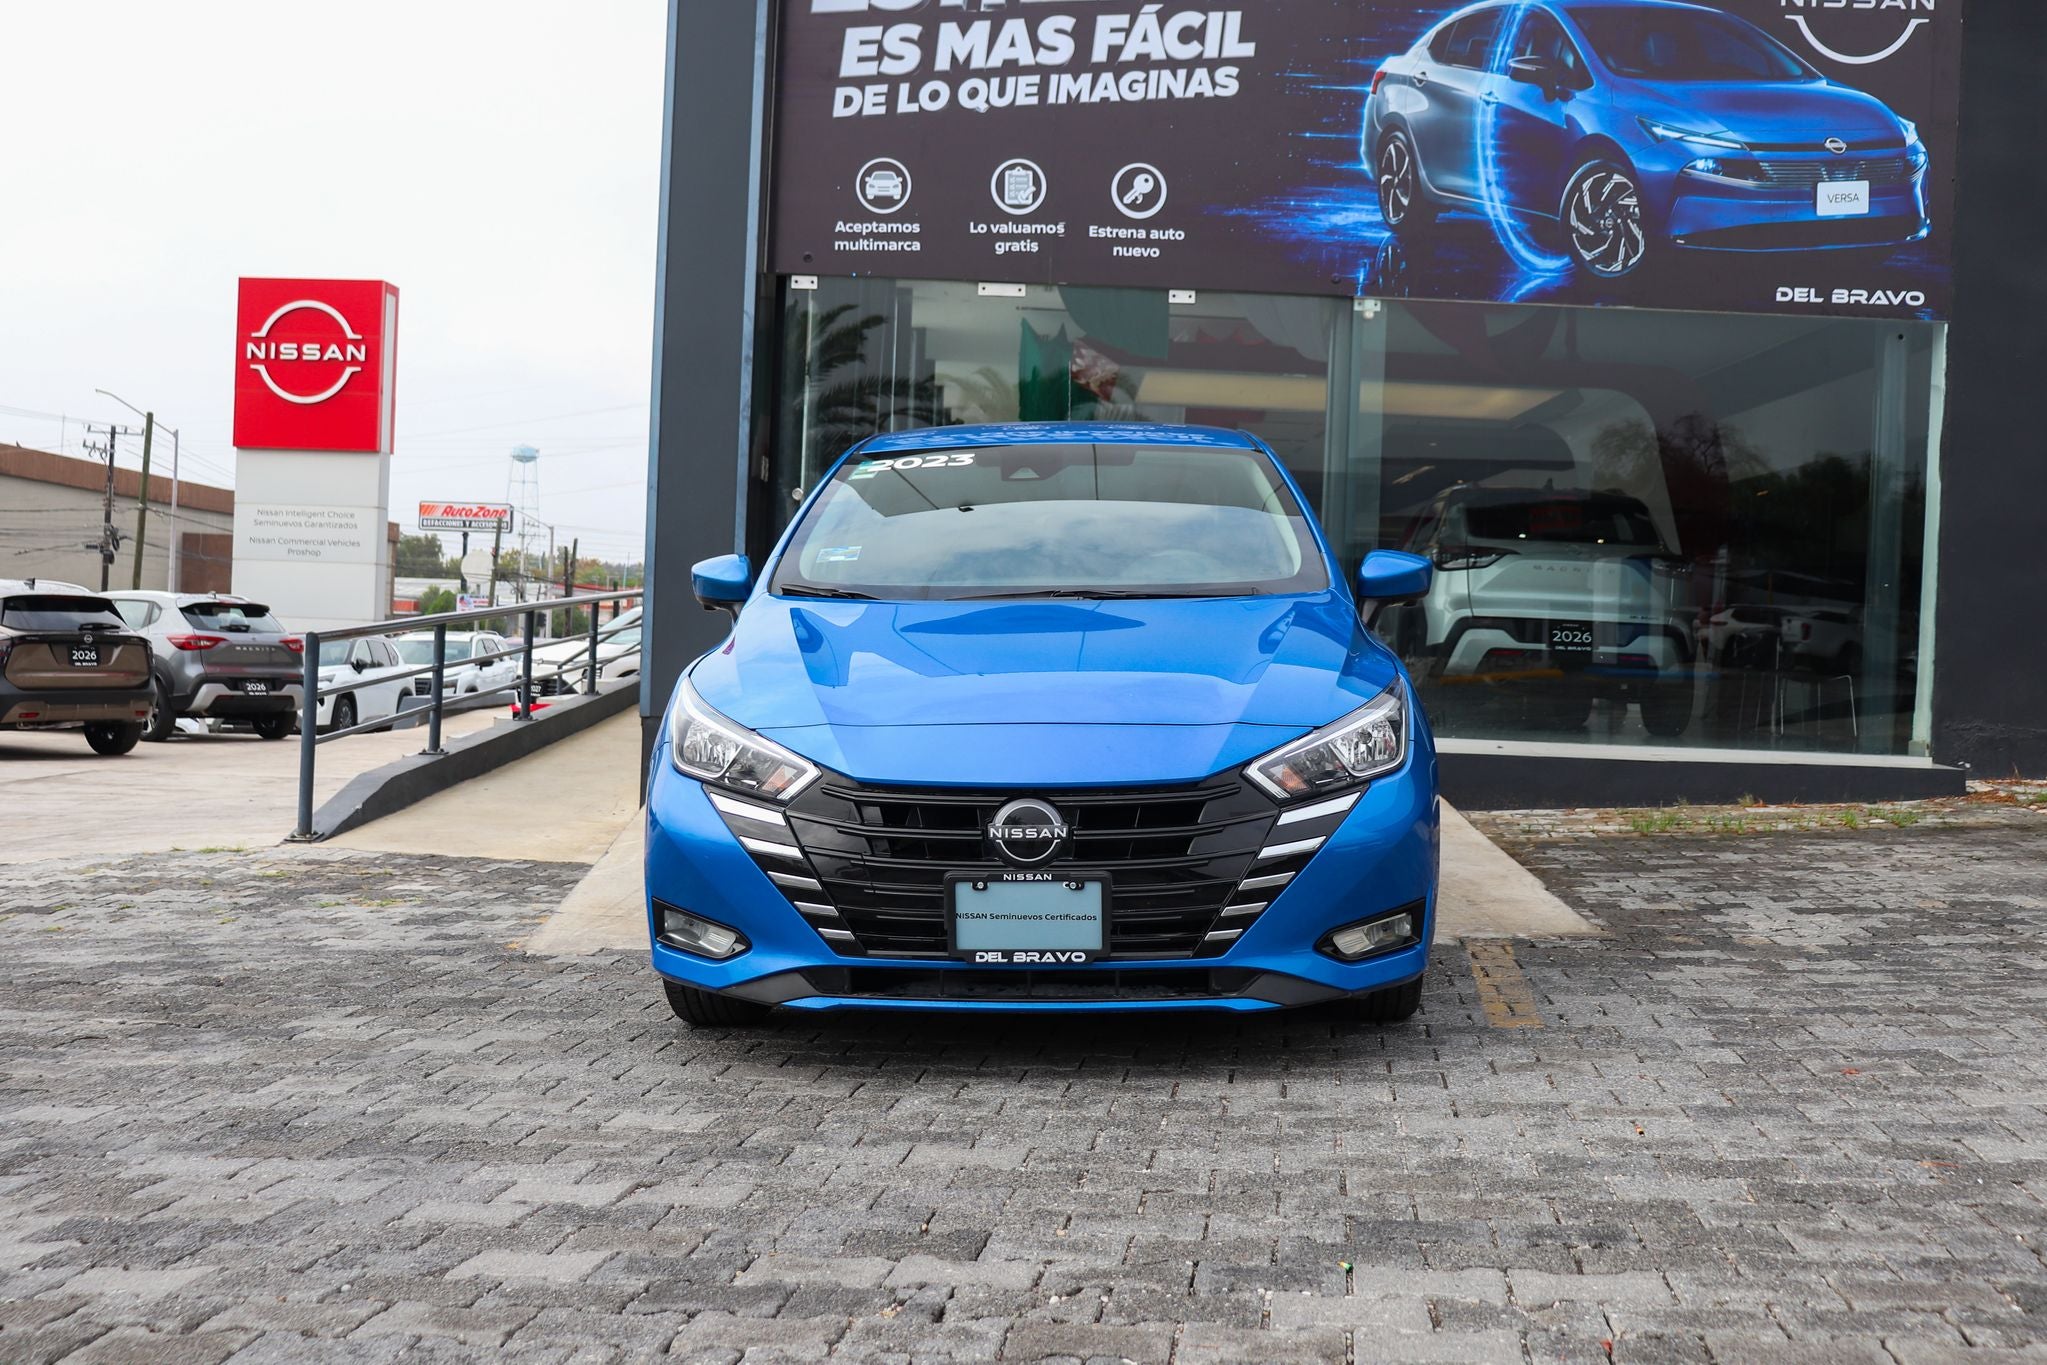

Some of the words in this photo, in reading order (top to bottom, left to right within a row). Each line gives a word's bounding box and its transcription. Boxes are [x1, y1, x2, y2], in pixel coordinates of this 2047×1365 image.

[838, 22, 923, 77] ES
[934, 15, 1077, 72] MAS
[1090, 4, 1256, 65] FÁCIL
[832, 84, 889, 118] DE
[896, 80, 951, 114] LO
[957, 74, 1041, 113] QUE
[1047, 65, 1240, 104] IMAGINAS
[1827, 193, 1860, 204] VERSA
[834, 221, 921, 235] Aceptamos
[969, 221, 988, 234] Lo
[990, 221, 1066, 235] valuamos
[1088, 225, 1147, 240] Estrena
[1150, 228, 1185, 241] auto
[834, 238, 921, 252] multimarca
[994, 239, 1040, 255] gratis
[1112, 245, 1160, 258] nuevo
[1775, 286, 1824, 303] DEL
[1831, 288, 1926, 306] BRAVO
[246, 342, 366, 362] NISSAN
[867, 453, 976, 472] 2023
[257, 509, 284, 517] Nissan
[285, 509, 325, 519] Intelligent
[327, 510, 355, 519] Choice
[253, 519, 302, 528] Seminuevos
[304, 520, 358, 529] Garantizados
[249, 536, 277, 544] Nissan
[277, 537, 326, 546] Commercial
[327, 538, 361, 547] Vehicles
[287, 548, 321, 557] Proshop
[1552, 630, 1592, 643] 2026
[72, 650, 97, 660] 2026
[246, 683, 266, 691] 2026
[989, 828, 1067, 838] NISSAN
[1003, 873, 1052, 881] NISSAN
[955, 912, 987, 920] NISSAN
[989, 912, 1043, 921] Seminuevos
[1044, 912, 1097, 921] Certificados
[975, 951, 1008, 963] DEL
[1013, 951, 1086, 963] BRAVO
